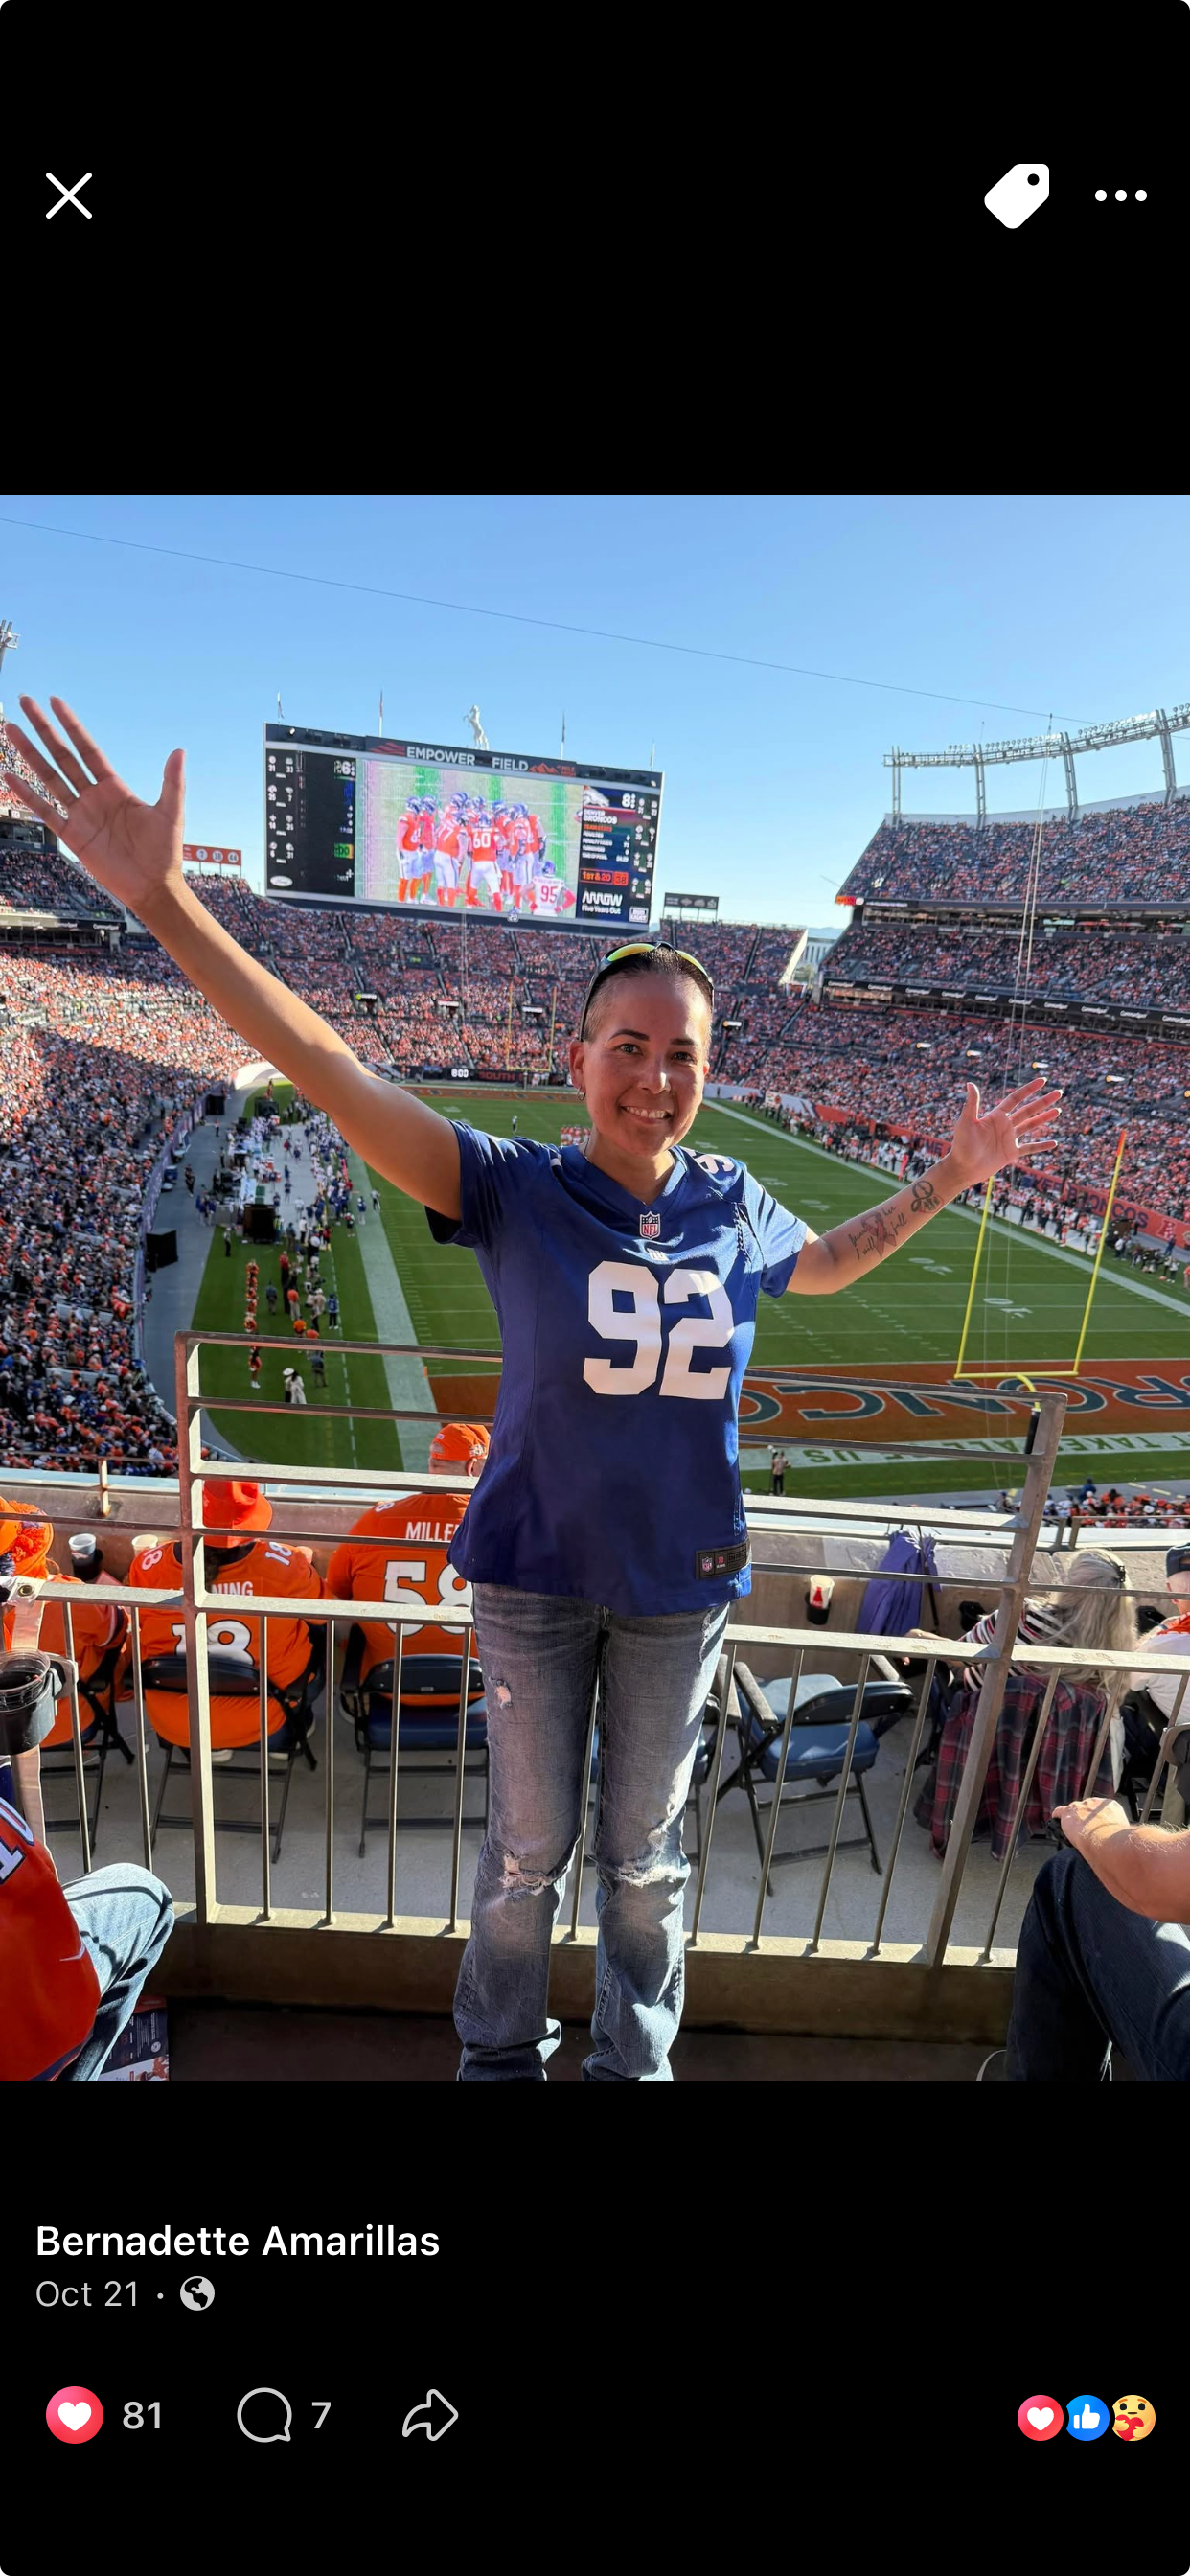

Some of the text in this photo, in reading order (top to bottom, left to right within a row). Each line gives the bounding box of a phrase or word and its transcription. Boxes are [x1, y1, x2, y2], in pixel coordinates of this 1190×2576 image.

[406, 746, 529, 771] EMPOWER FIELD
[622, 793, 631, 808] 8
[583, 815, 618, 824] BRONCOS
[473, 832, 491, 849] 60
[601, 873, 611, 882] 20
[540, 886, 558, 904] 95
[609, 907, 622, 915] Out
[643, 1224, 659, 1236] NFL
[583, 1260, 735, 1400] 92
[265, 1541, 292, 1566] 18
[383, 1560, 473, 1636] 58
